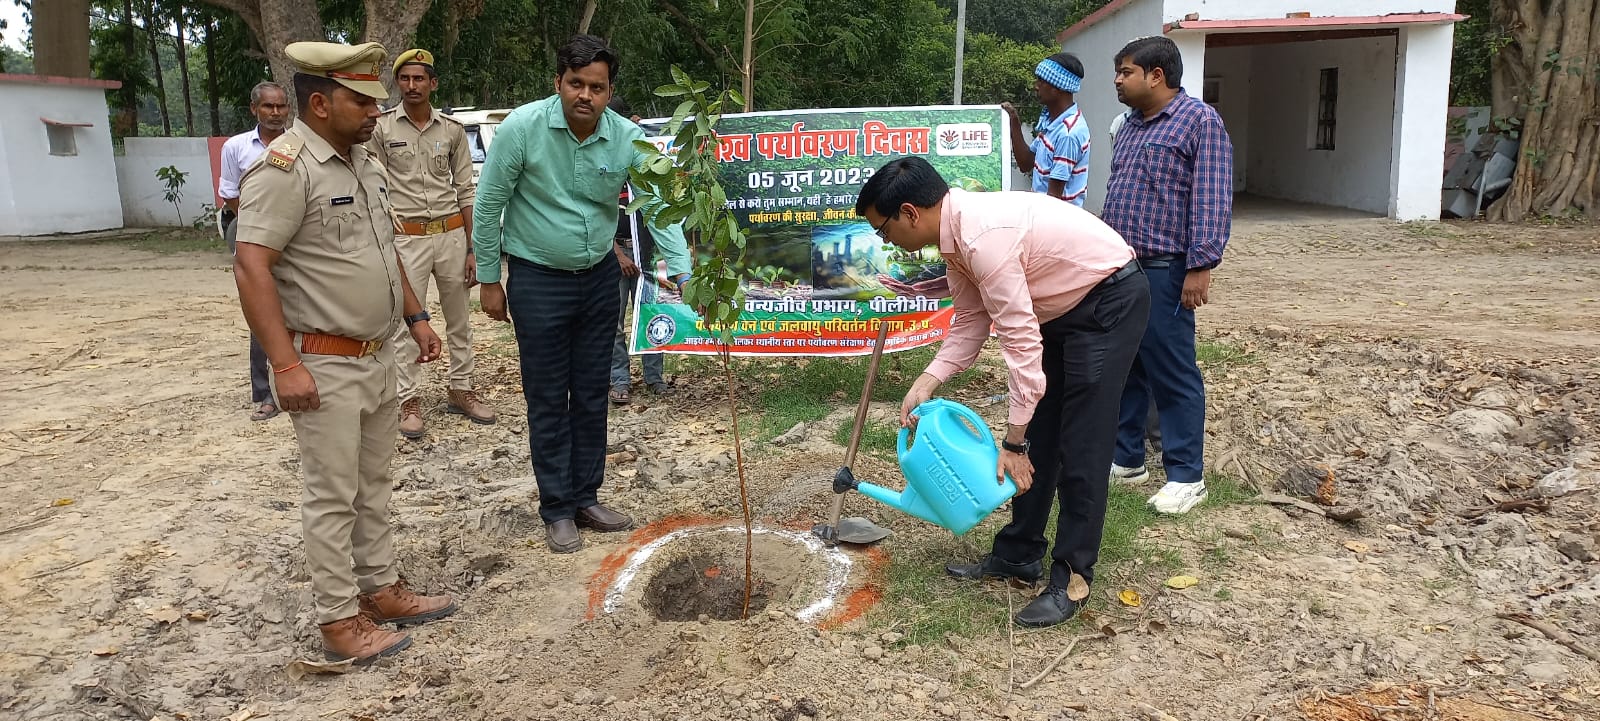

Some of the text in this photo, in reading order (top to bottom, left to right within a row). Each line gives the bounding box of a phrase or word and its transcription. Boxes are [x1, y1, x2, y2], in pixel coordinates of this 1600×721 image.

[756, 122, 858, 160] पर्यावरण
[863, 121, 931, 157] दिवस
[962, 130, 988, 141] LiFE
[748, 171, 775, 189] 05
[780, 170, 814, 193] जून
[738, 196, 746, 209] से
[747, 196, 761, 209] करो
[763, 198, 776, 211] तुम
[833, 192, 853, 205] हमारे
[748, 210, 781, 224] पर्यावरण
[782, 209, 793, 222] की
[822, 207, 846, 221] जीवन
[744, 296, 807, 313] वन्यजीव
[811, 298, 863, 316] प्रभाग,
[869, 295, 941, 313] पीलीभीत
[741, 319, 757, 332] वन
[760, 316, 776, 332] एवं
[779, 319, 822, 337] जलवायु
[824, 317, 867, 332] परिवर्तन
[796, 338, 806, 347] पर
[807, 337, 837, 347] पर्यावरण
[839, 336, 864, 347] संरक्षण
